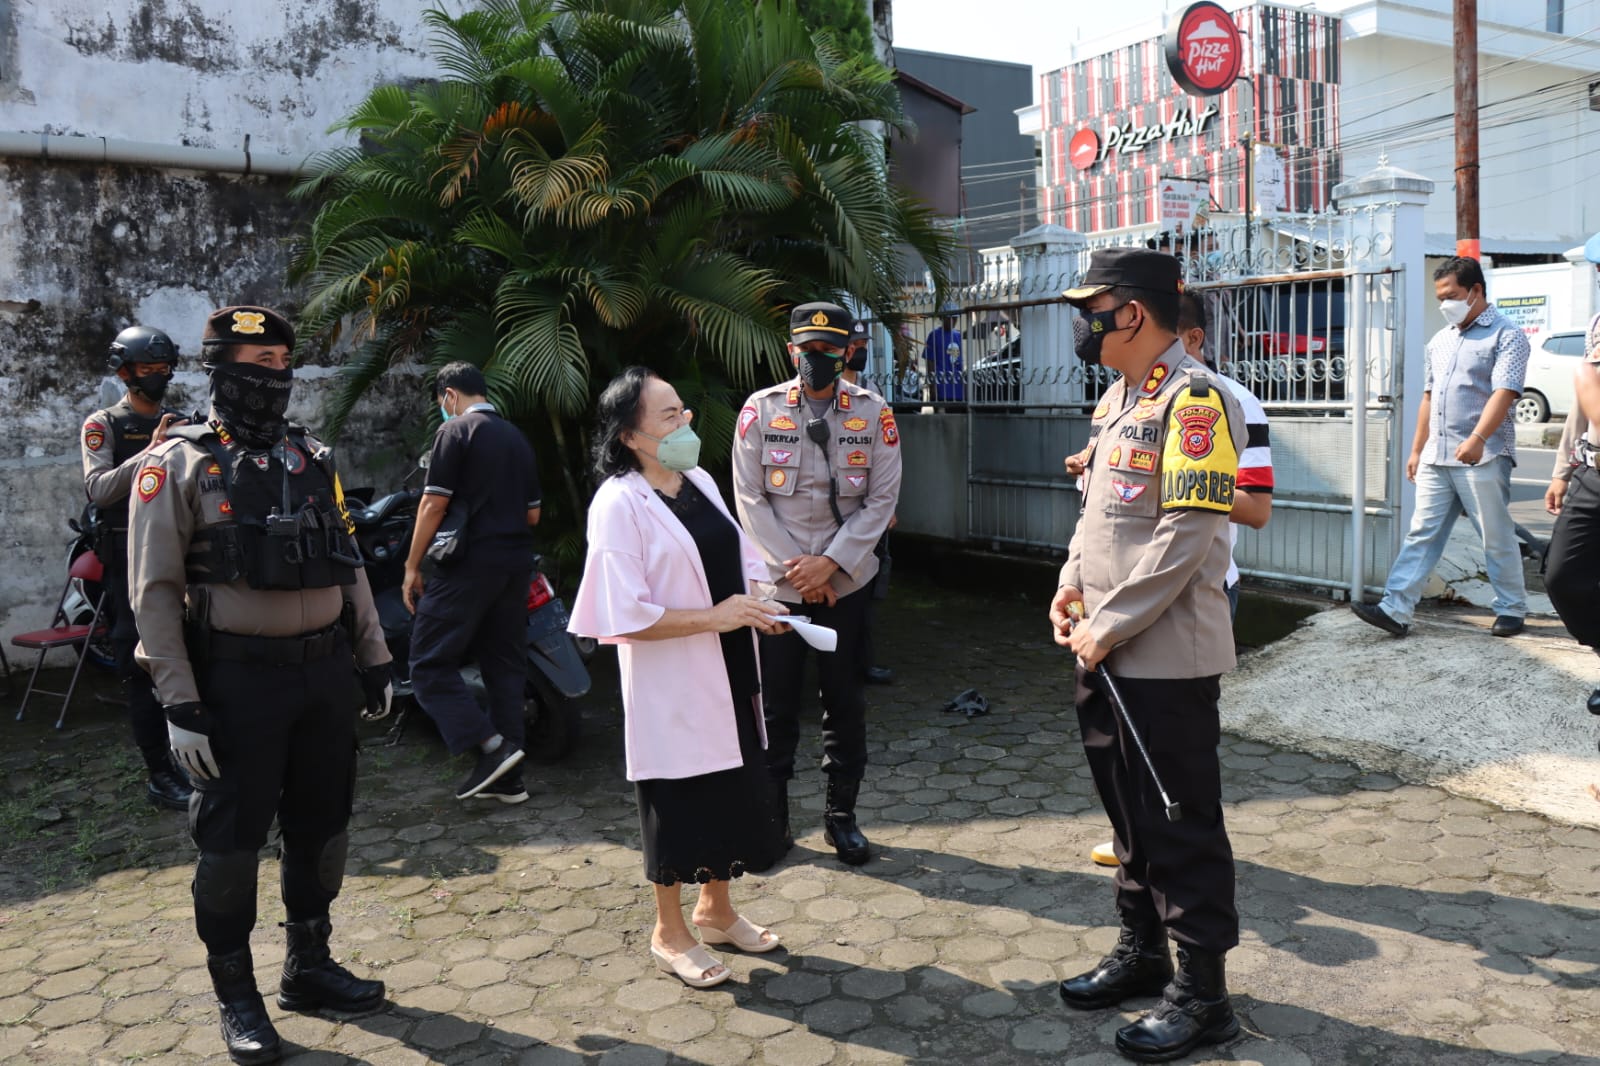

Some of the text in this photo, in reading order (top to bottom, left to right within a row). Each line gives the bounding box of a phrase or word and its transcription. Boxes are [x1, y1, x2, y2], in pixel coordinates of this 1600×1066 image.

[1188, 39, 1231, 67] Pizza
[1195, 56, 1226, 77] Hut
[1101, 106, 1217, 160] Pizza Hut
[839, 436, 872, 445] POLISI
[1119, 425, 1158, 443] POLRI
